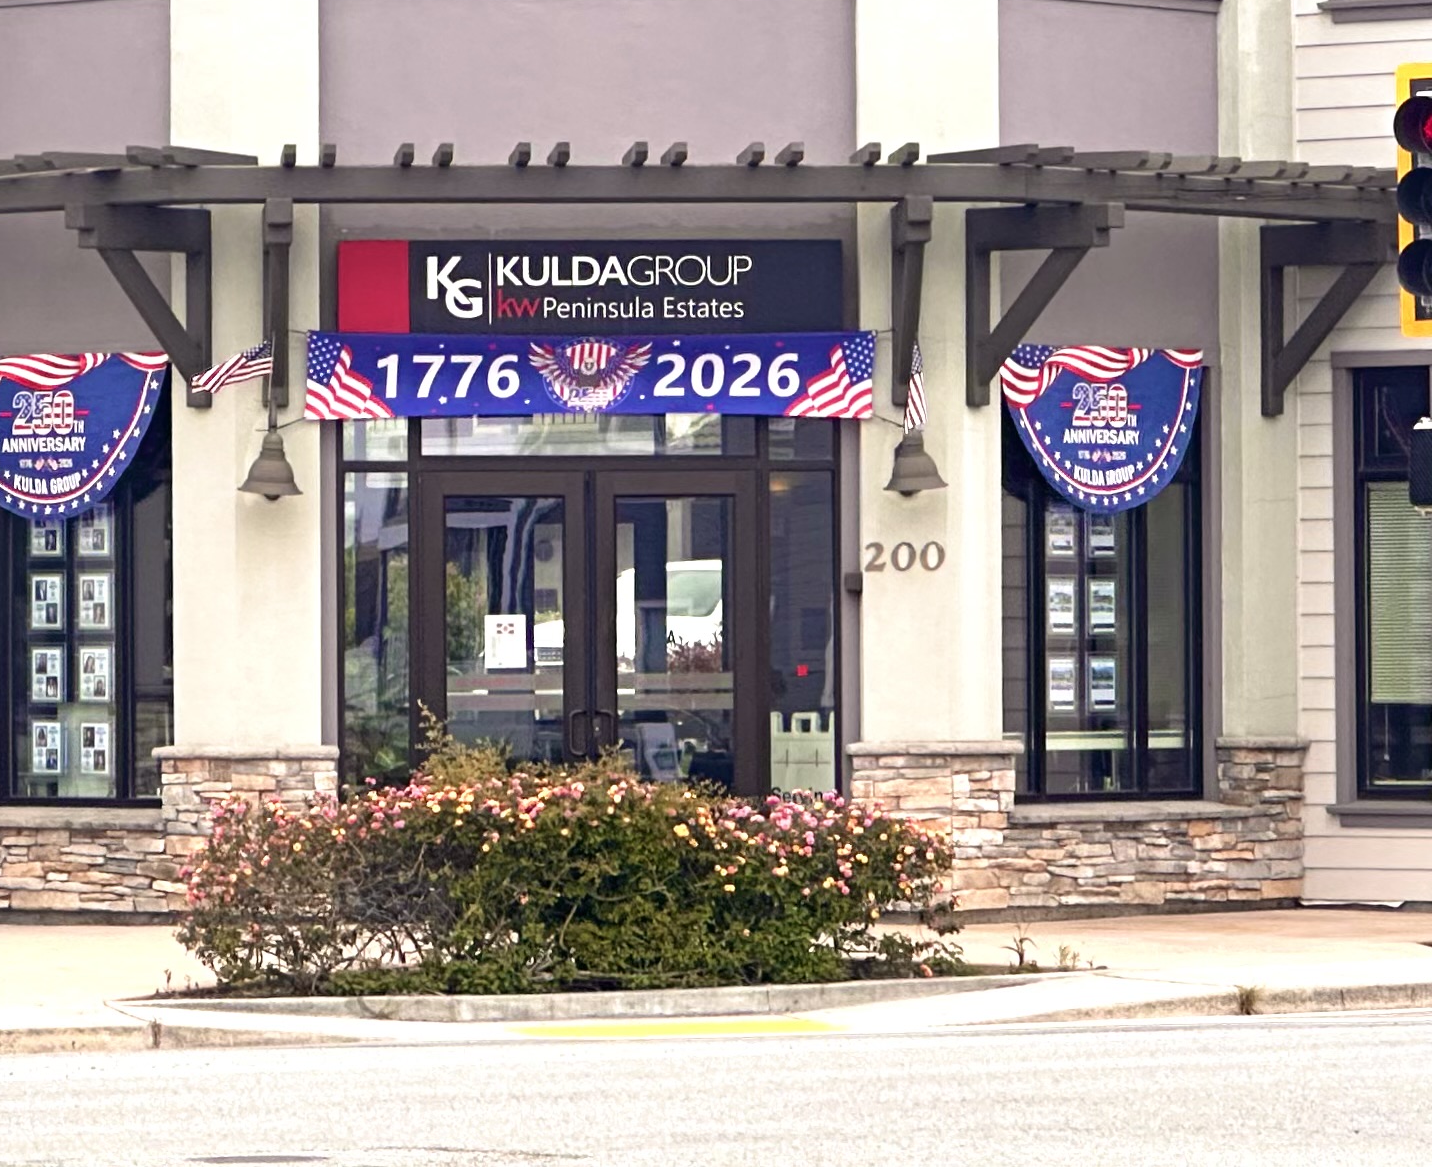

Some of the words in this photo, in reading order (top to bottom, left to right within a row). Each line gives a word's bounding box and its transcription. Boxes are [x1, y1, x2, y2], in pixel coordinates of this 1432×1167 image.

[496, 255, 753, 287] KULDAGROUP
[496, 294, 540, 319] kw
[543, 296, 655, 319] Peninsula
[663, 296, 745, 319] Estates
[376, 353, 521, 399] 1776
[652, 352, 801, 398] 2026
[2, 436, 86, 453] ANNIVERSARY
[1063, 428, 1140, 446] ANNIVERSARY
[14, 473, 49, 495] KULDA
[50, 471, 82, 495] GROUP
[1073, 464, 1105, 486] KULDA
[864, 541, 946, 573] 200
